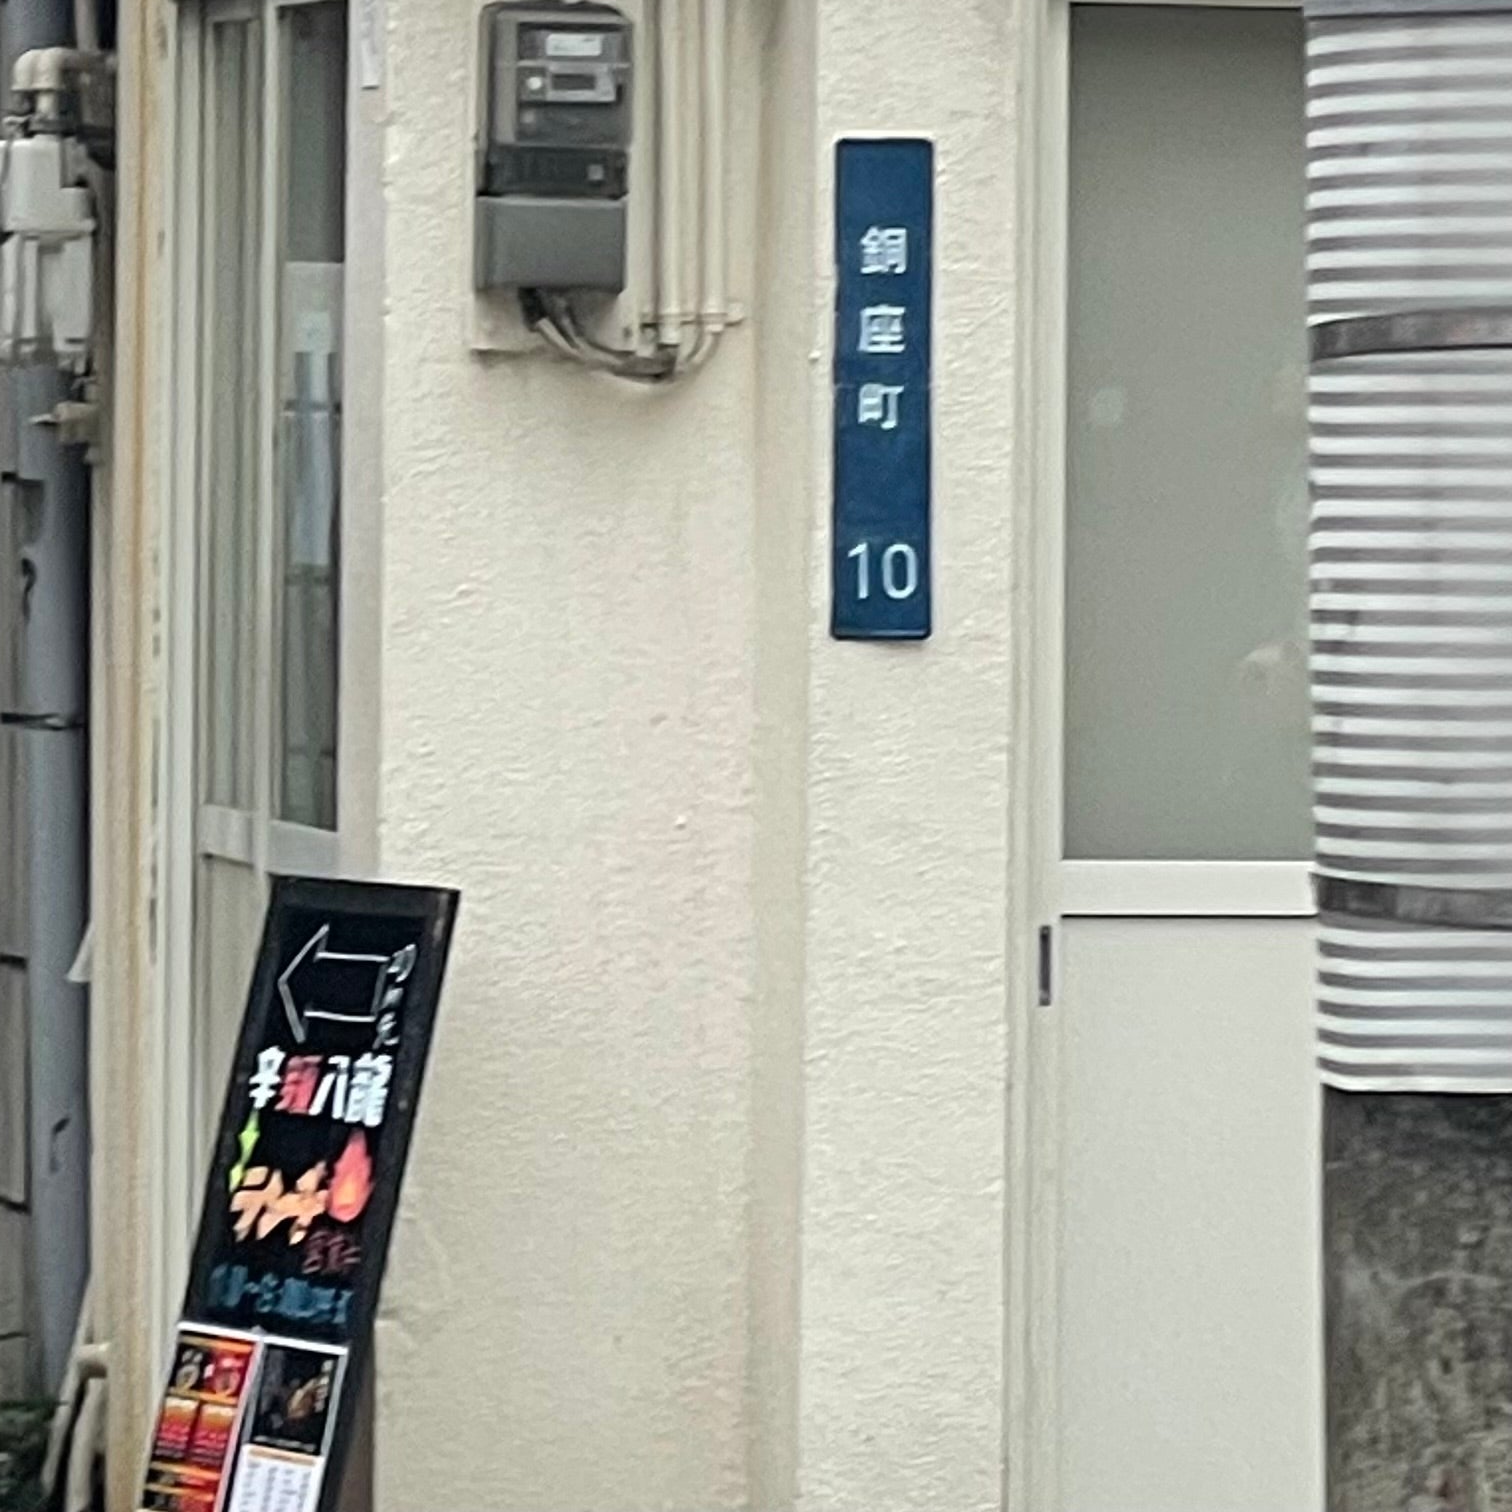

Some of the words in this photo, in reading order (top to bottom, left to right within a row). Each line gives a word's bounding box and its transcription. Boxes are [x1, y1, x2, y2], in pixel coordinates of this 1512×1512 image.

[858, 227, 907, 429] 銅座町
[848, 542, 919, 599] 10
